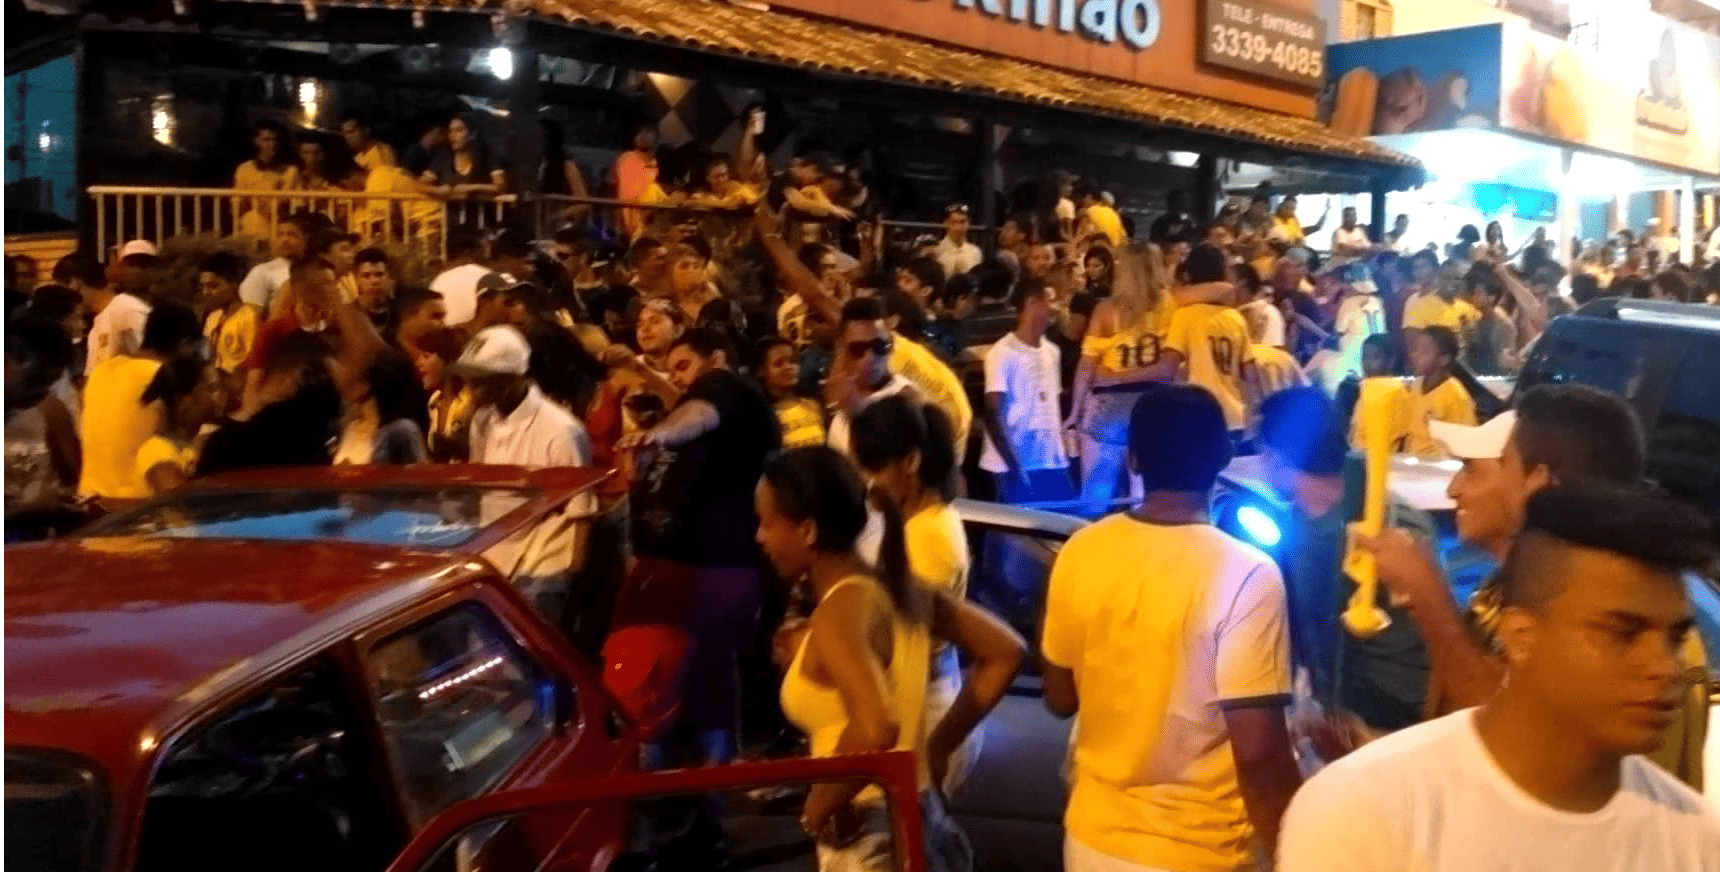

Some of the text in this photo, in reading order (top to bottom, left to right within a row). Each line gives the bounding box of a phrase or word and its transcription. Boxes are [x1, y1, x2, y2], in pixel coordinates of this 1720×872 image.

[1222, 2, 1253, 25] TELE
[1211, 23, 1323, 78] 3339-4085
[1117, 332, 1160, 368] 10
